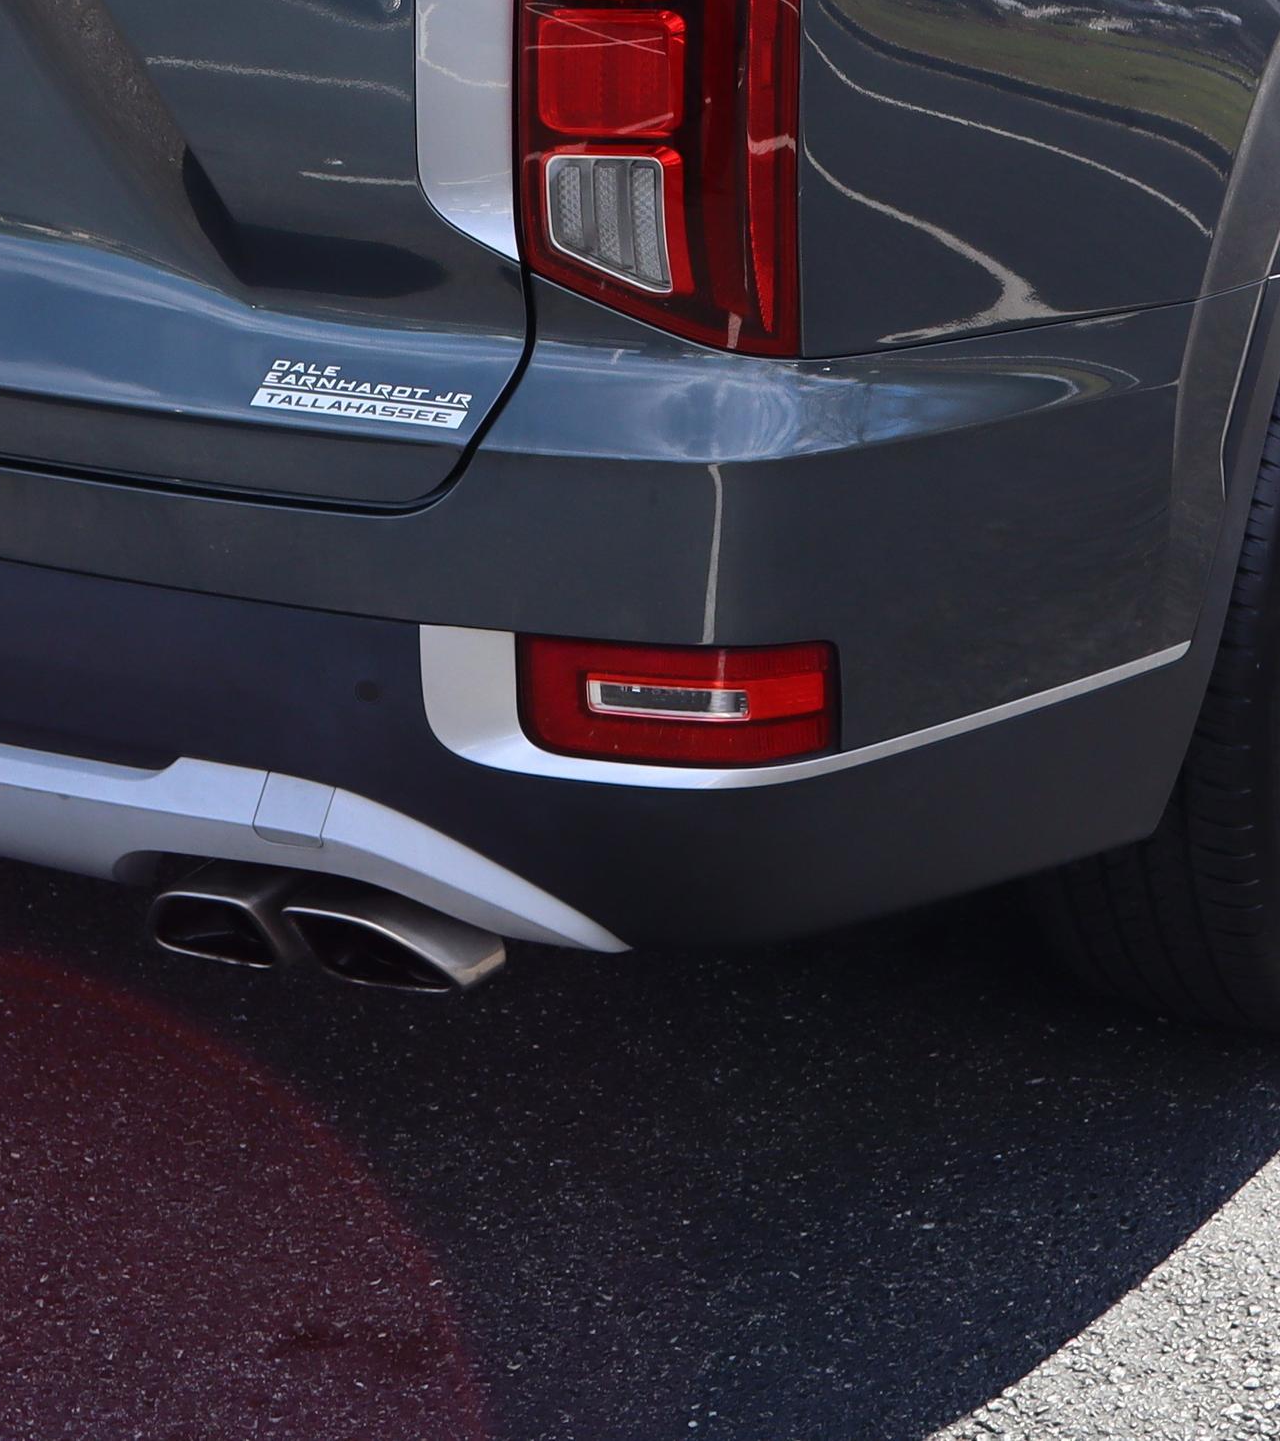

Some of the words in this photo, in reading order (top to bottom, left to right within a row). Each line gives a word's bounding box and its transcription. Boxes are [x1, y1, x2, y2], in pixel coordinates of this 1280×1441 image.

[271, 360, 341, 377] DALE
[264, 371, 429, 400] EARNHARDT
[435, 392, 472, 408] JR
[266, 392, 453, 424] TALLAHASSEE
